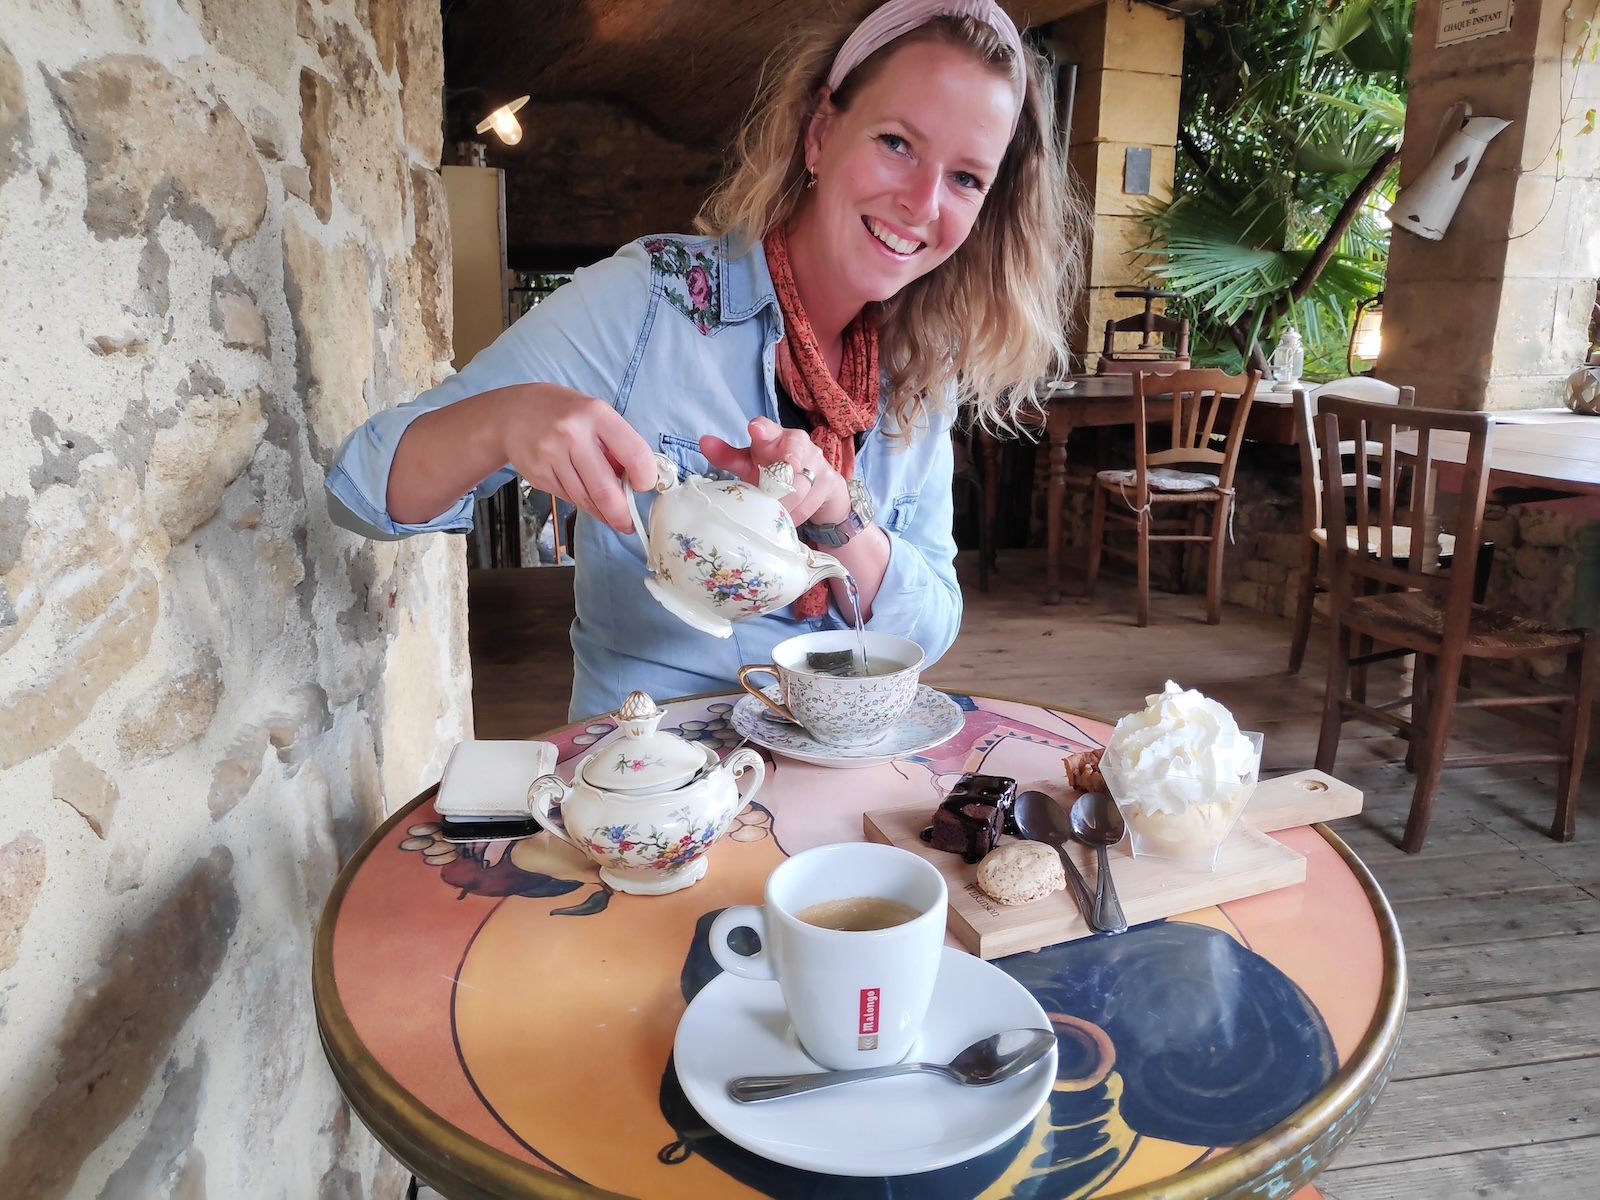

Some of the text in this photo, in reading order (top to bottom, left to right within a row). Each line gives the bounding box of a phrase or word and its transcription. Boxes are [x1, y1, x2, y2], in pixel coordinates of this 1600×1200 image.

[1443, 11, 1502, 32] CHAQUE INSTANT
[963, 883, 1000, 917] Wilkinson
[862, 990, 878, 1032] Malongo
